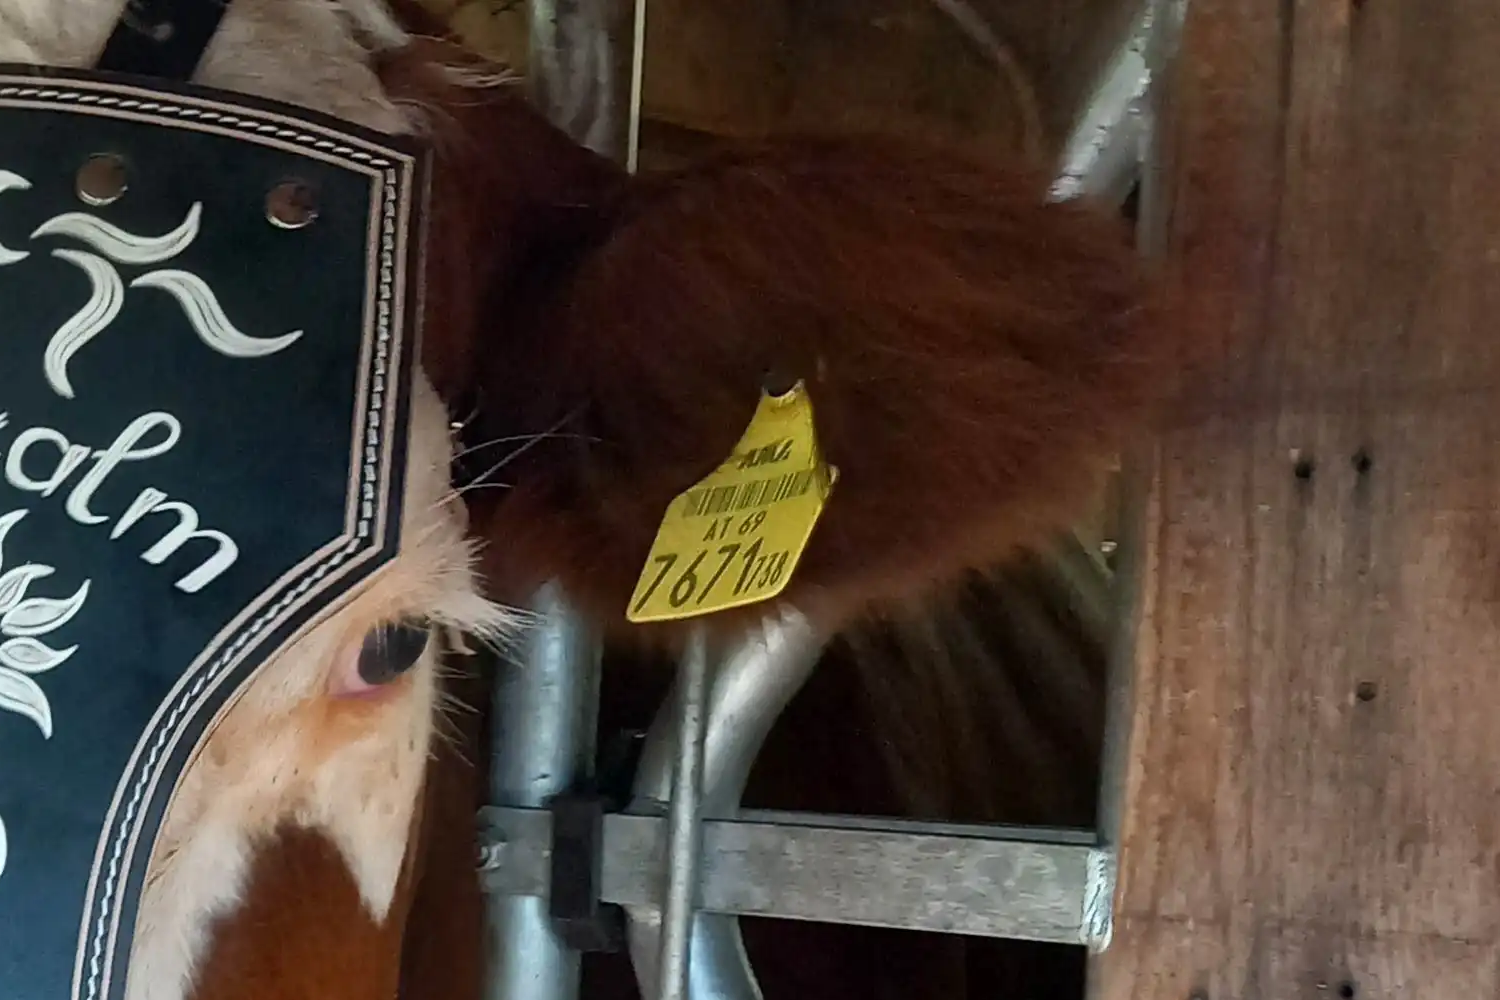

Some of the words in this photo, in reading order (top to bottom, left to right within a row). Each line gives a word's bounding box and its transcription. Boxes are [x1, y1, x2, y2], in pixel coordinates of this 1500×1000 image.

[702, 516, 735, 542] AT
[738, 509, 769, 536] 69
[633, 536, 765, 613] 7671
